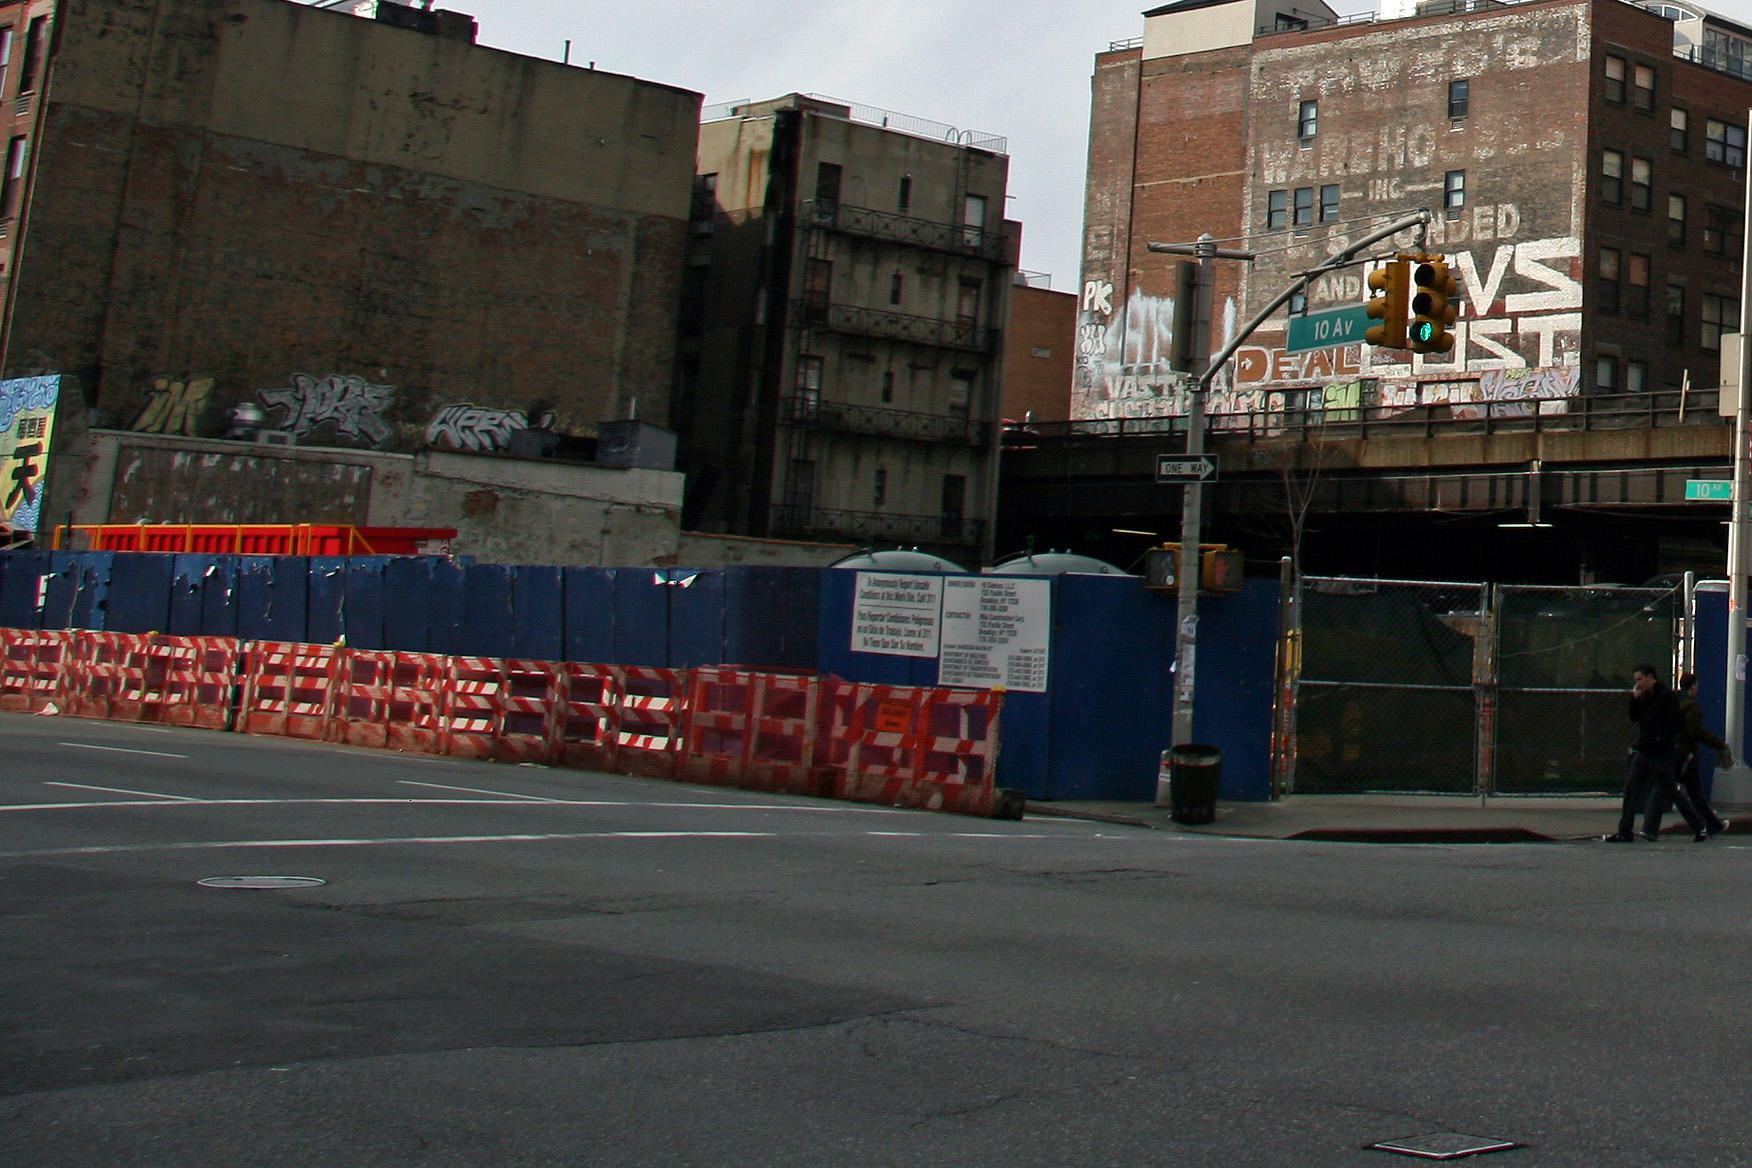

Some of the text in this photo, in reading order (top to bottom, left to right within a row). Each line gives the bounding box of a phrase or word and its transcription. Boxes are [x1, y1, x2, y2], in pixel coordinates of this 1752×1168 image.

[1314, 274, 1362, 301] AND
[1314, 317, 1354, 341] 10 Av
[1165, 463, 1209, 474] ONE WAY
[1696, 483, 1711, 498] 10
